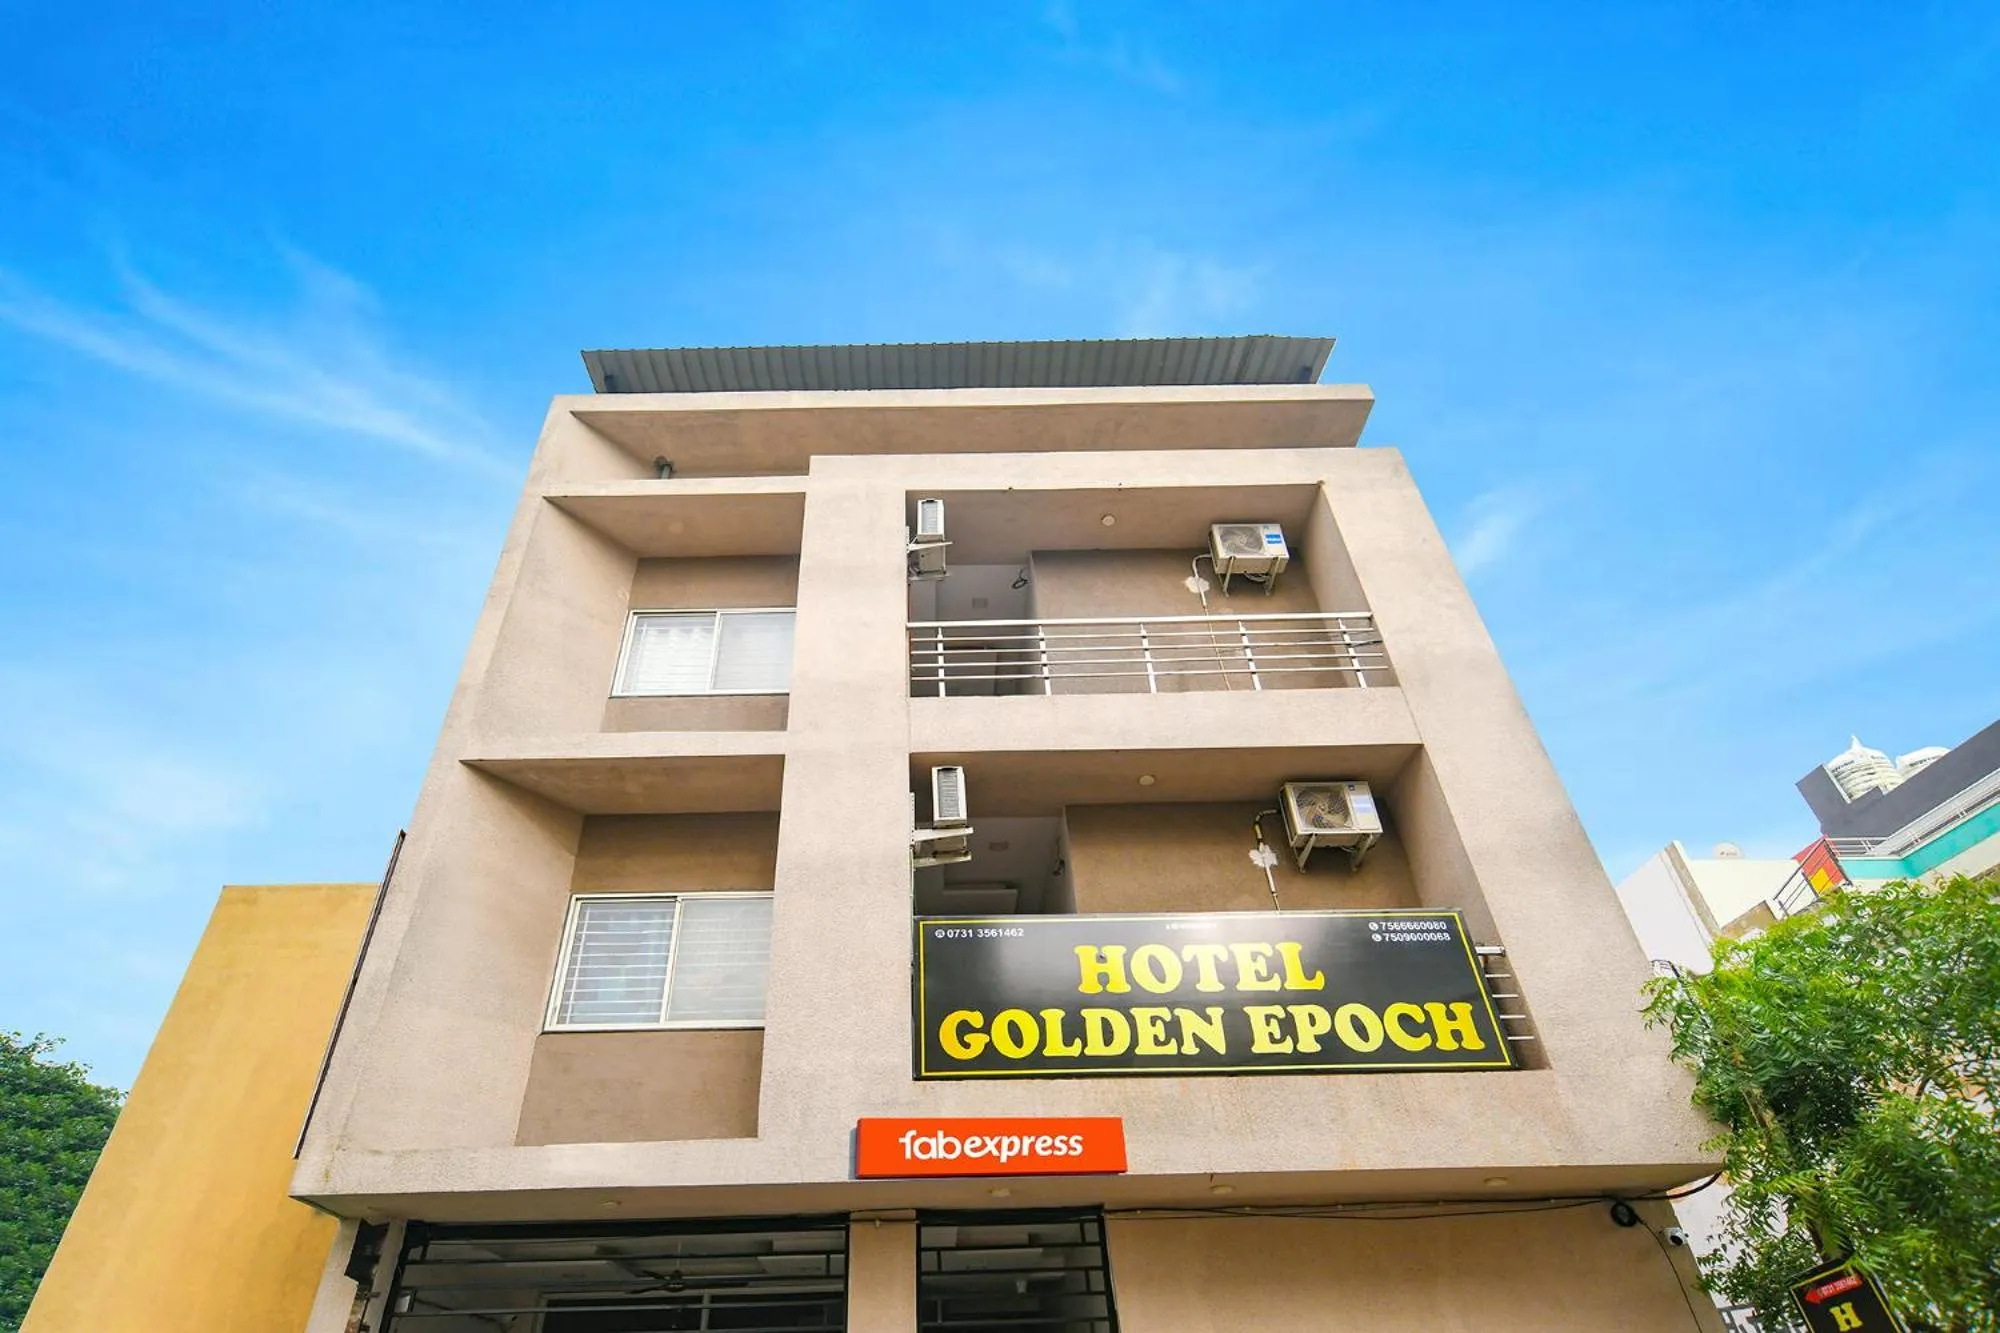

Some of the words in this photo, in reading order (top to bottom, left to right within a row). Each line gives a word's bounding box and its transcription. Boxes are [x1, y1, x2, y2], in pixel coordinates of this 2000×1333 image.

[946, 928, 973, 938] 0731
[977, 927, 1025, 938] 3561462
[1074, 941, 1325, 994] HOTEL
[938, 1006, 1226, 1060] GOLDEN
[1243, 1001, 1486, 1056] EPOCH
[898, 1129, 1084, 1163] fabexpress
[1829, 1301, 1864, 1332] H
